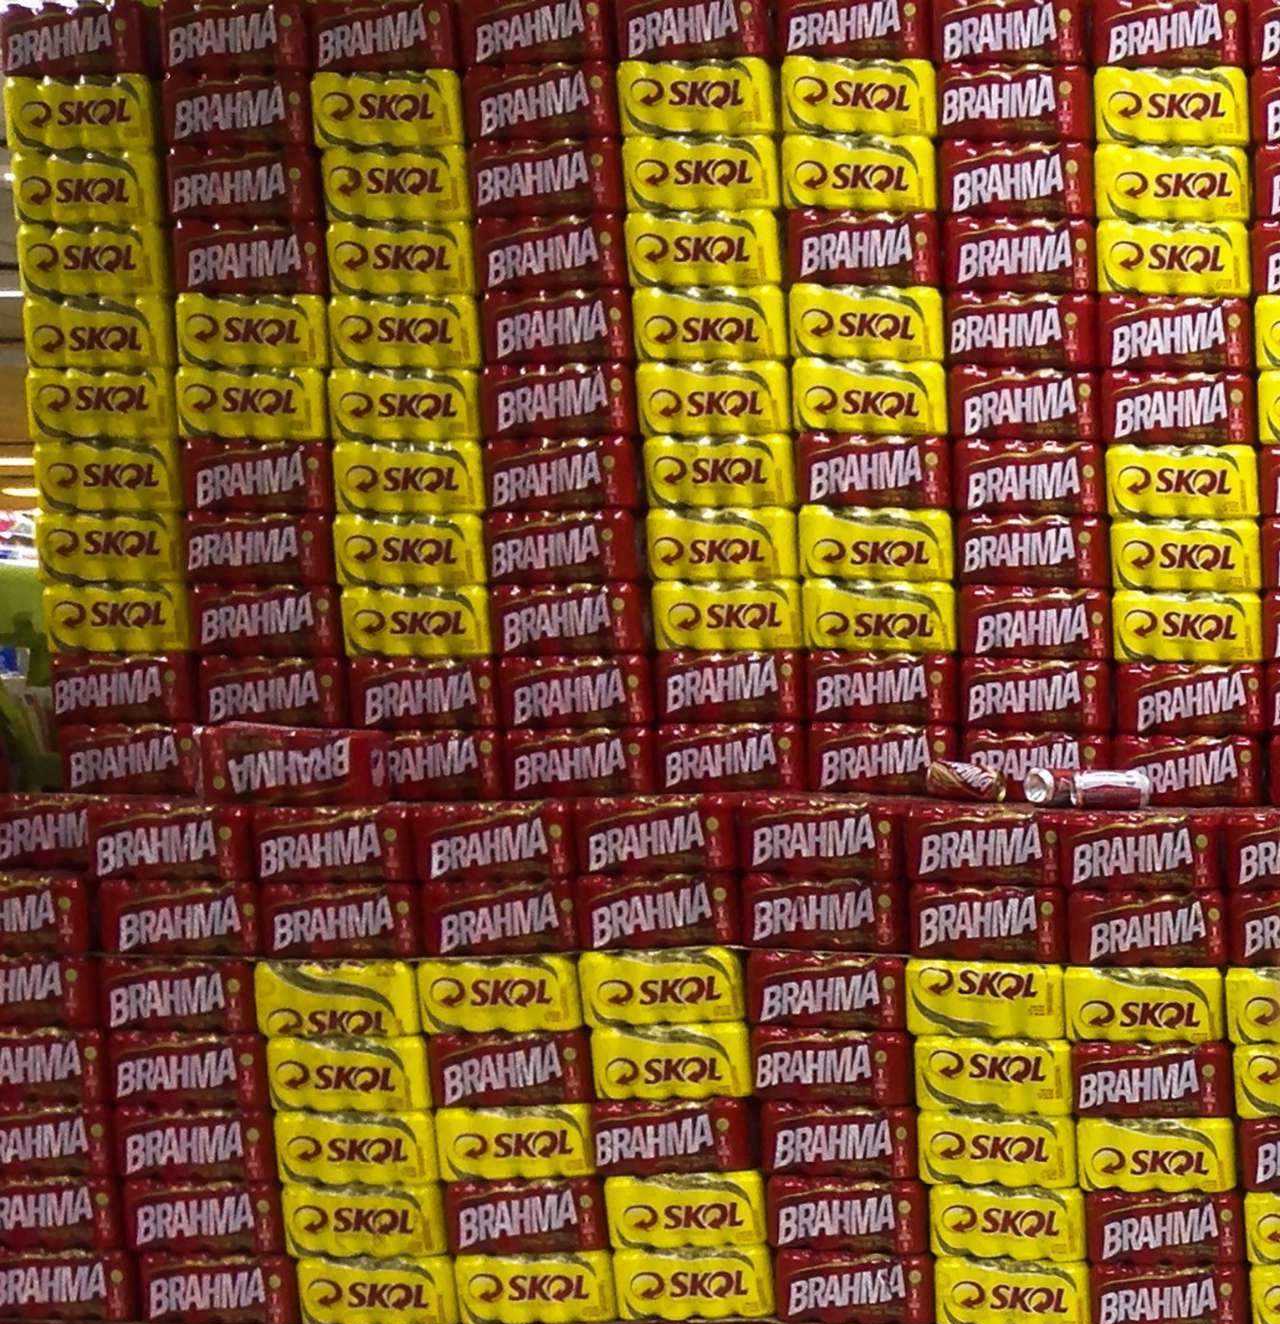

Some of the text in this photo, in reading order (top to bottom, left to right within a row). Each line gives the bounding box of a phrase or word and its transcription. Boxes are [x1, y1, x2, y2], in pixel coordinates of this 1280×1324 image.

[4, 14, 112, 73] BRAHMA
[476, 0, 584, 62] BRAHMA
[1107, 2, 1230, 63] BRAHMA
[58, 100, 131, 127] SKOL
[175, 86, 285, 138] BRAHMA
[358, 93, 434, 122] SKOL
[669, 80, 743, 109] SKOL
[942, 74, 1056, 125] BRAHMA
[1148, 93, 1223, 120] SKOL
[478, 151, 588, 206] BRAHMA
[833, 164, 908, 192] SKOL
[63, 245, 137, 273] SKOL
[188, 235, 301, 286] BRAHMA
[373, 244, 451, 273] SKOL
[800, 224, 913, 277] BRAHMA
[1149, 245, 1223, 273] SKOL
[497, 300, 608, 358] BRAHMA
[839, 313, 914, 340] SKOL
[1111, 301, 1227, 366] BRAHMA
[70, 385, 149, 414] SKOL
[379, 393, 454, 420] SKOL
[197, 447, 304, 507] BRAHMA
[493, 451, 601, 506] BRAHMA
[692, 458, 767, 485] SKOL
[810, 445, 922, 501] BRAHMA
[1156, 469, 1230, 496] SKOL
[964, 527, 1076, 572] BRAHMA
[390, 611, 466, 637] SKOL
[504, 588, 610, 651] BRAHMA
[854, 613, 933, 639] SKOL
[1163, 612, 1236, 641] SKOL
[56, 666, 161, 714] BRAHMA
[667, 656, 778, 713] BRAHMA
[968, 670, 1081, 721] BRAHMA
[228, 736, 350, 794] BRAHMA
[589, 811, 704, 871] BRAHMA
[919, 822, 1042, 874] BRAHMA
[120, 896, 241, 951] BRAHMA
[440, 892, 559, 953] BRAHMA
[753, 888, 874, 940] BRAHMA
[1090, 901, 1206, 961] BRAHMA
[958, 971, 1037, 1000] SKOL
[308, 1010, 387, 1035] SKOL
[117, 1048, 236, 1097] BRAHMA
[444, 1042, 562, 1105] BRAHMA
[645, 1057, 722, 1084] SKOL
[756, 1045, 872, 1088] BRAHMA
[1079, 1059, 1199, 1108] BRAHMA
[1131, 1150, 1208, 1175] SKOL
[137, 1193, 254, 1245] BRAHMA
[334, 1208, 414, 1235] SKOL
[460, 1189, 577, 1248] BRAHMA
[778, 1194, 895, 1245] BRAHMA
[1102, 1203, 1218, 1260] BRAHMA
[509, 1275, 589, 1302] SKOL
[991, 1285, 1067, 1313] SKOL
